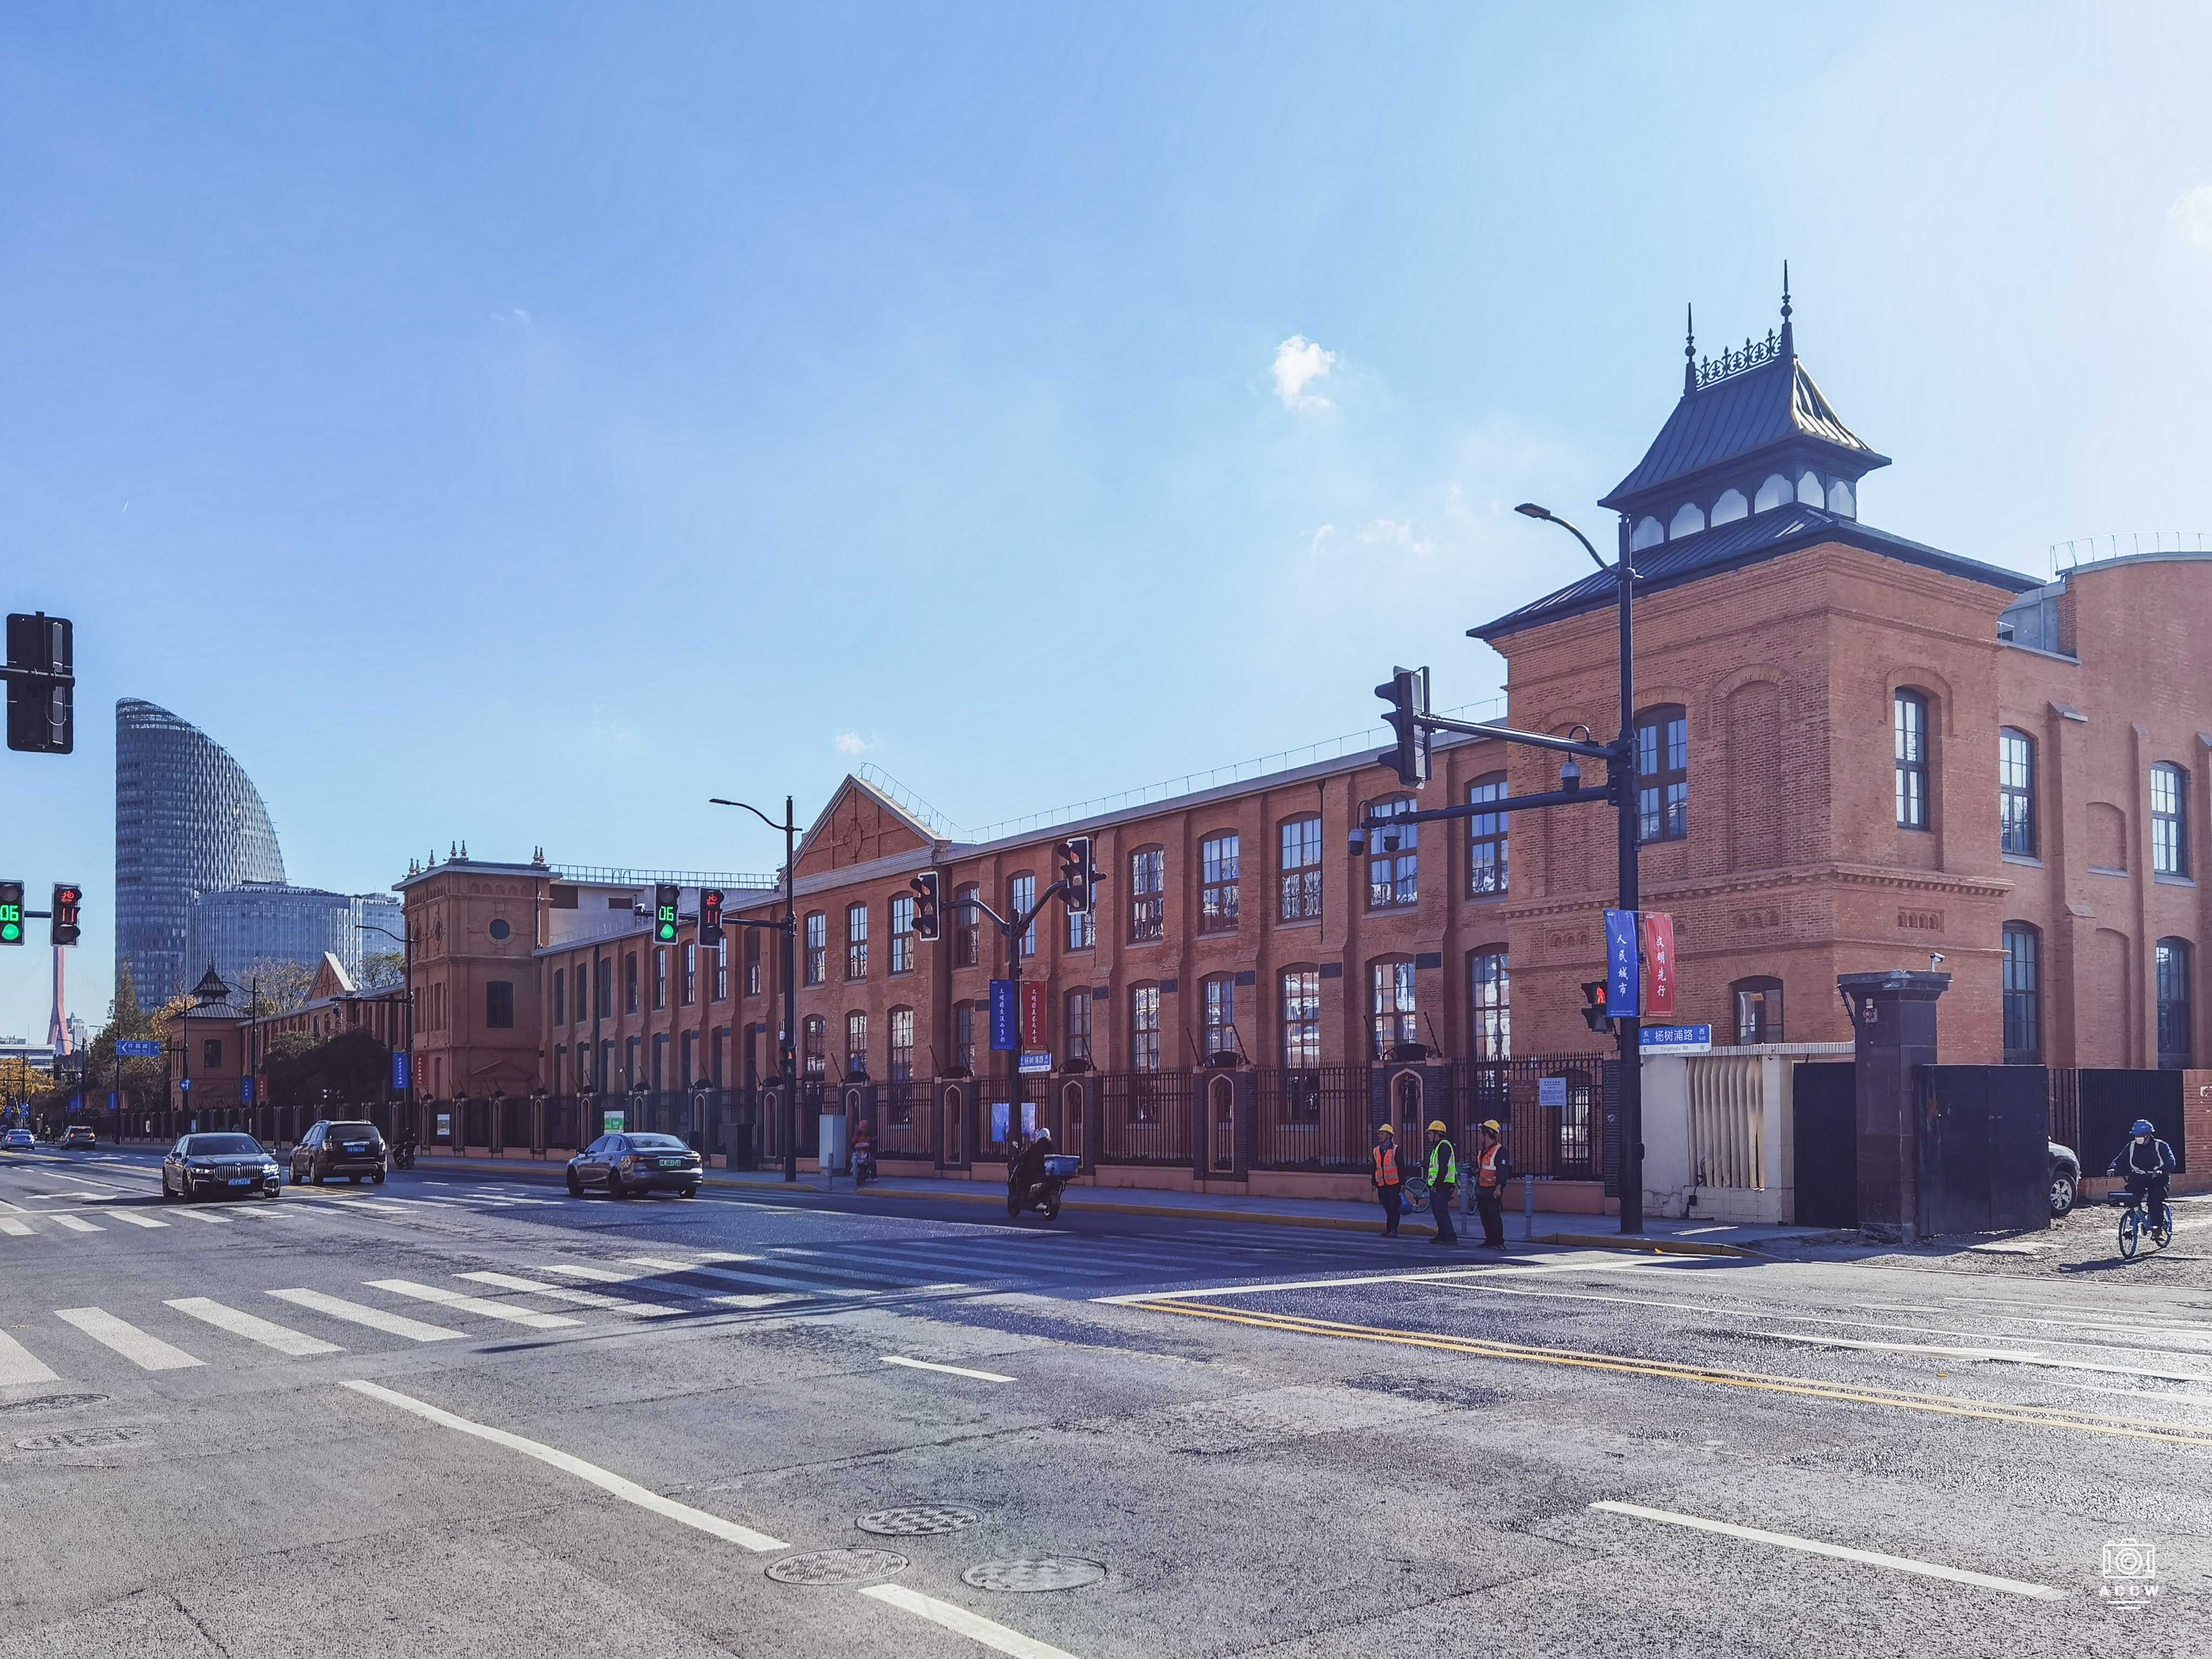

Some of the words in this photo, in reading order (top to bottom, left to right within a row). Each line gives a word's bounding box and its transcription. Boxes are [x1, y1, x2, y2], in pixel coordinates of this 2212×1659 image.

[0, 905, 19, 921] 06
[62, 908, 75, 922] 11
[659, 906, 674, 921] 06
[707, 910, 718, 924] 11
[1616, 934, 1628, 997] 人民城市
[1656, 936, 1667, 997] 文明先行
[1655, 1029, 1693, 1042] 杨树浦路
